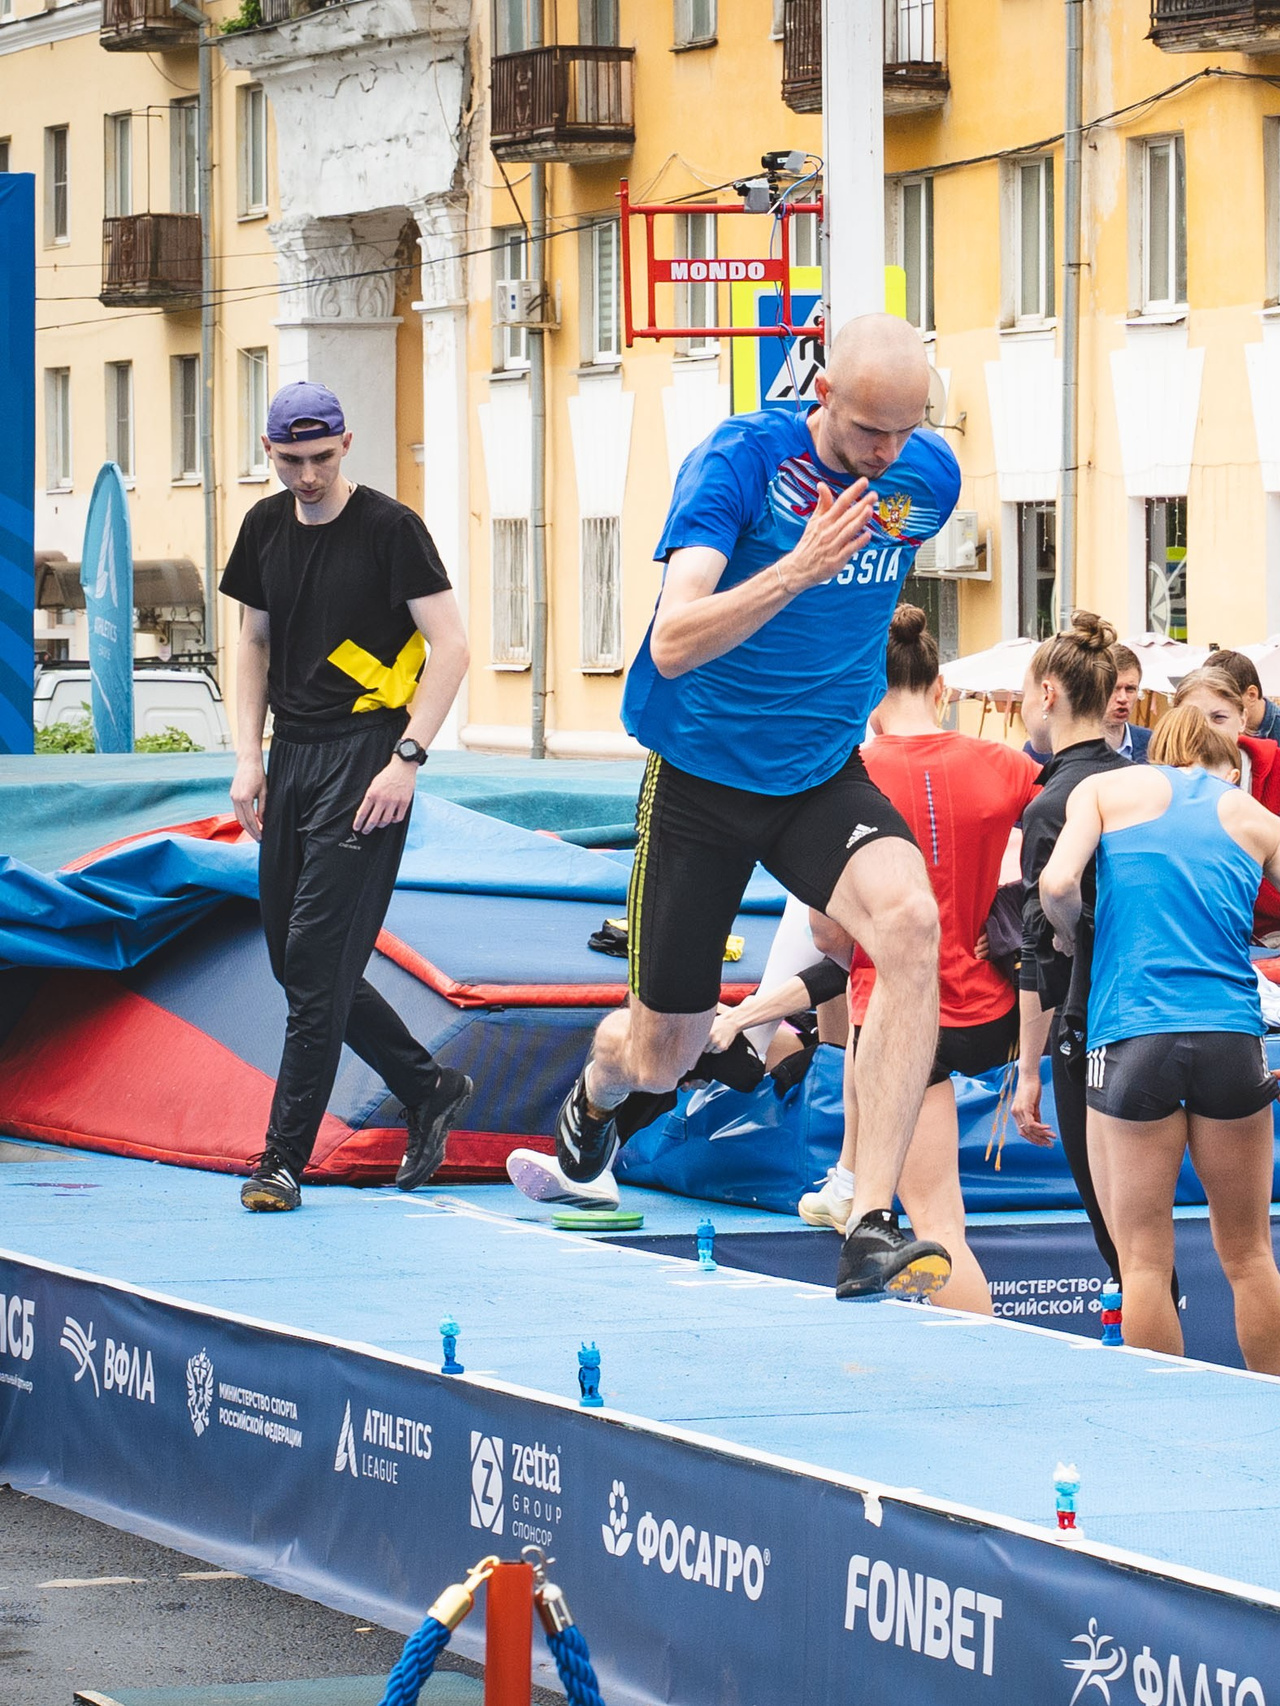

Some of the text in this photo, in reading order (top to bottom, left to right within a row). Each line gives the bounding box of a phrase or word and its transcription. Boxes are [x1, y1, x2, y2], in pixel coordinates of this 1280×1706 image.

[671, 262, 765, 280] MONDO
[819, 547, 902, 585] SSIA
[986, 1277, 1100, 1296] ИНИСТЕРСТВО
[992, 1296, 1084, 1317] ССИЙСКОЙ
[104, 1337, 155, 1404] ВФЛА
[219, 1382, 298, 1420] МИНИСТЕРСТВО СПОРТА
[219, 1406, 303, 1448] РОССИЙСКОЙ ФЕДЕРАЦИИ
[363, 1408, 432, 1460] ATHLETICS
[362, 1453, 399, 1485] LEAGUE
[512, 1493, 562, 1524] GROUP
[511, 1520, 552, 1547] СПОНСОР
[845, 1554, 1002, 1676] FONBET
